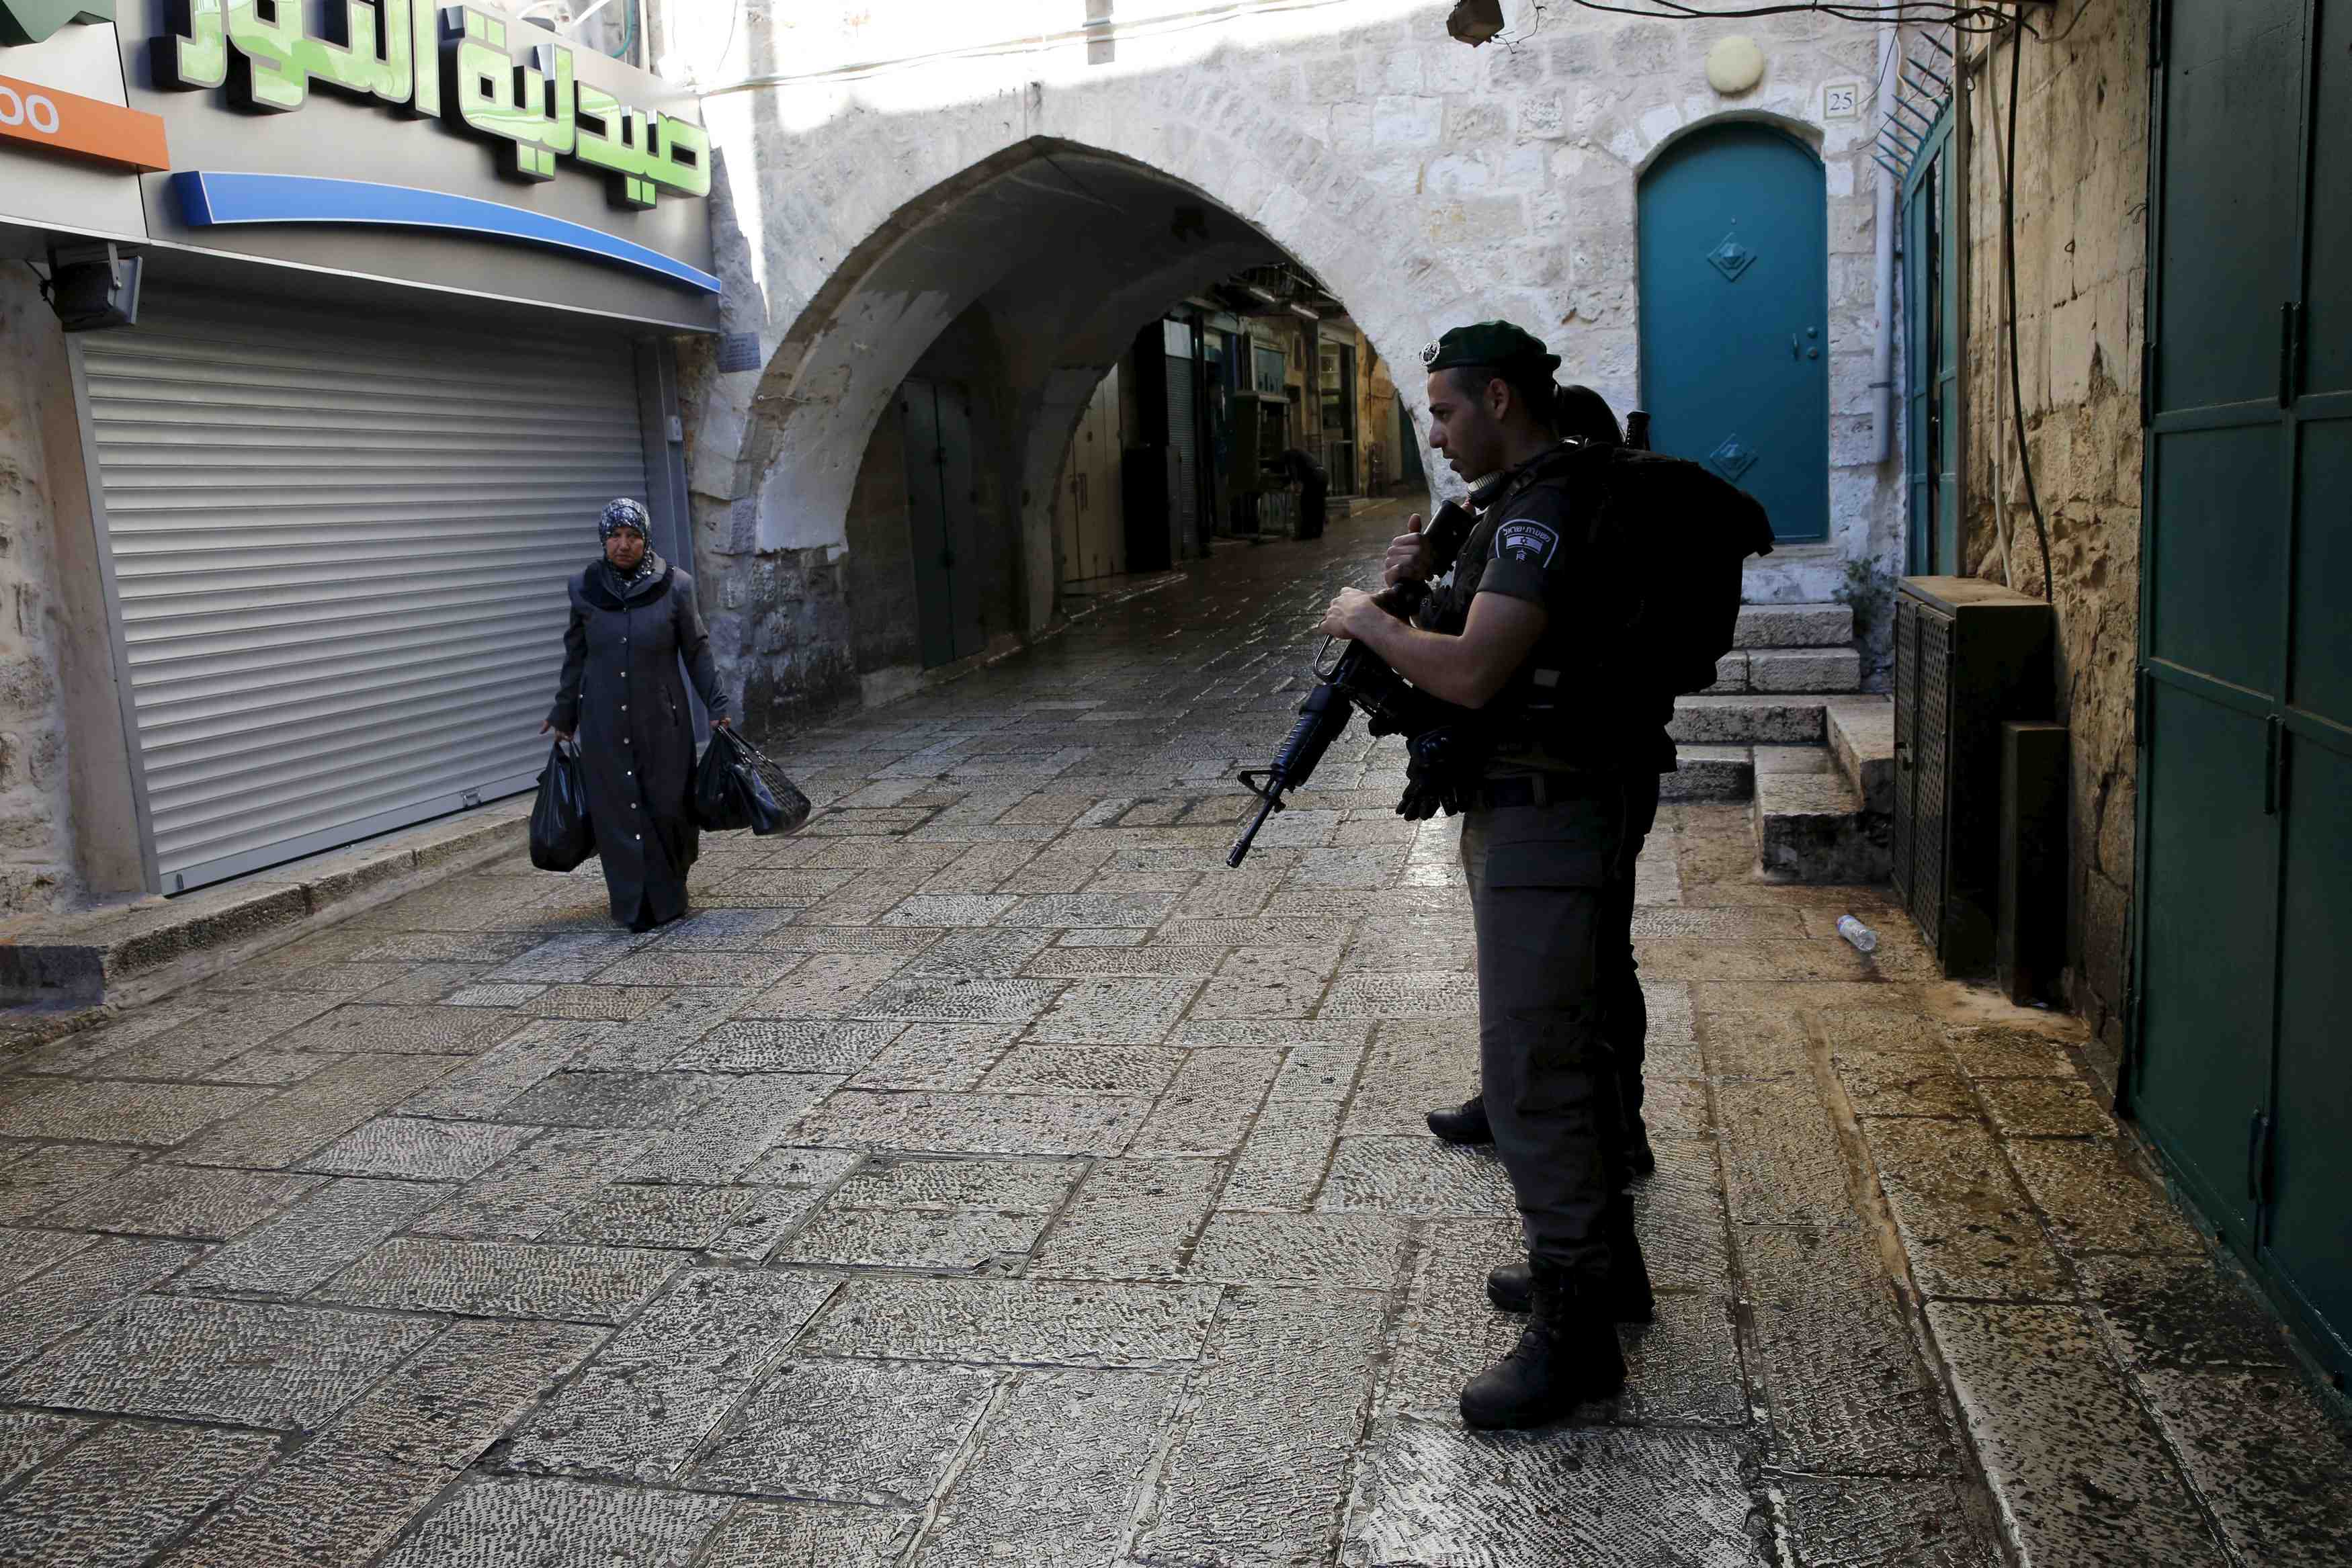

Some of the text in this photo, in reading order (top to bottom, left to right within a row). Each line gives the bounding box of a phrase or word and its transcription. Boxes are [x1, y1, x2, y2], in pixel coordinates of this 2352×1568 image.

[458, 6, 711, 209] صيدلية
[1829, 91, 1853, 110] 25
[1503, 526, 1551, 542] משטרת ישראל
